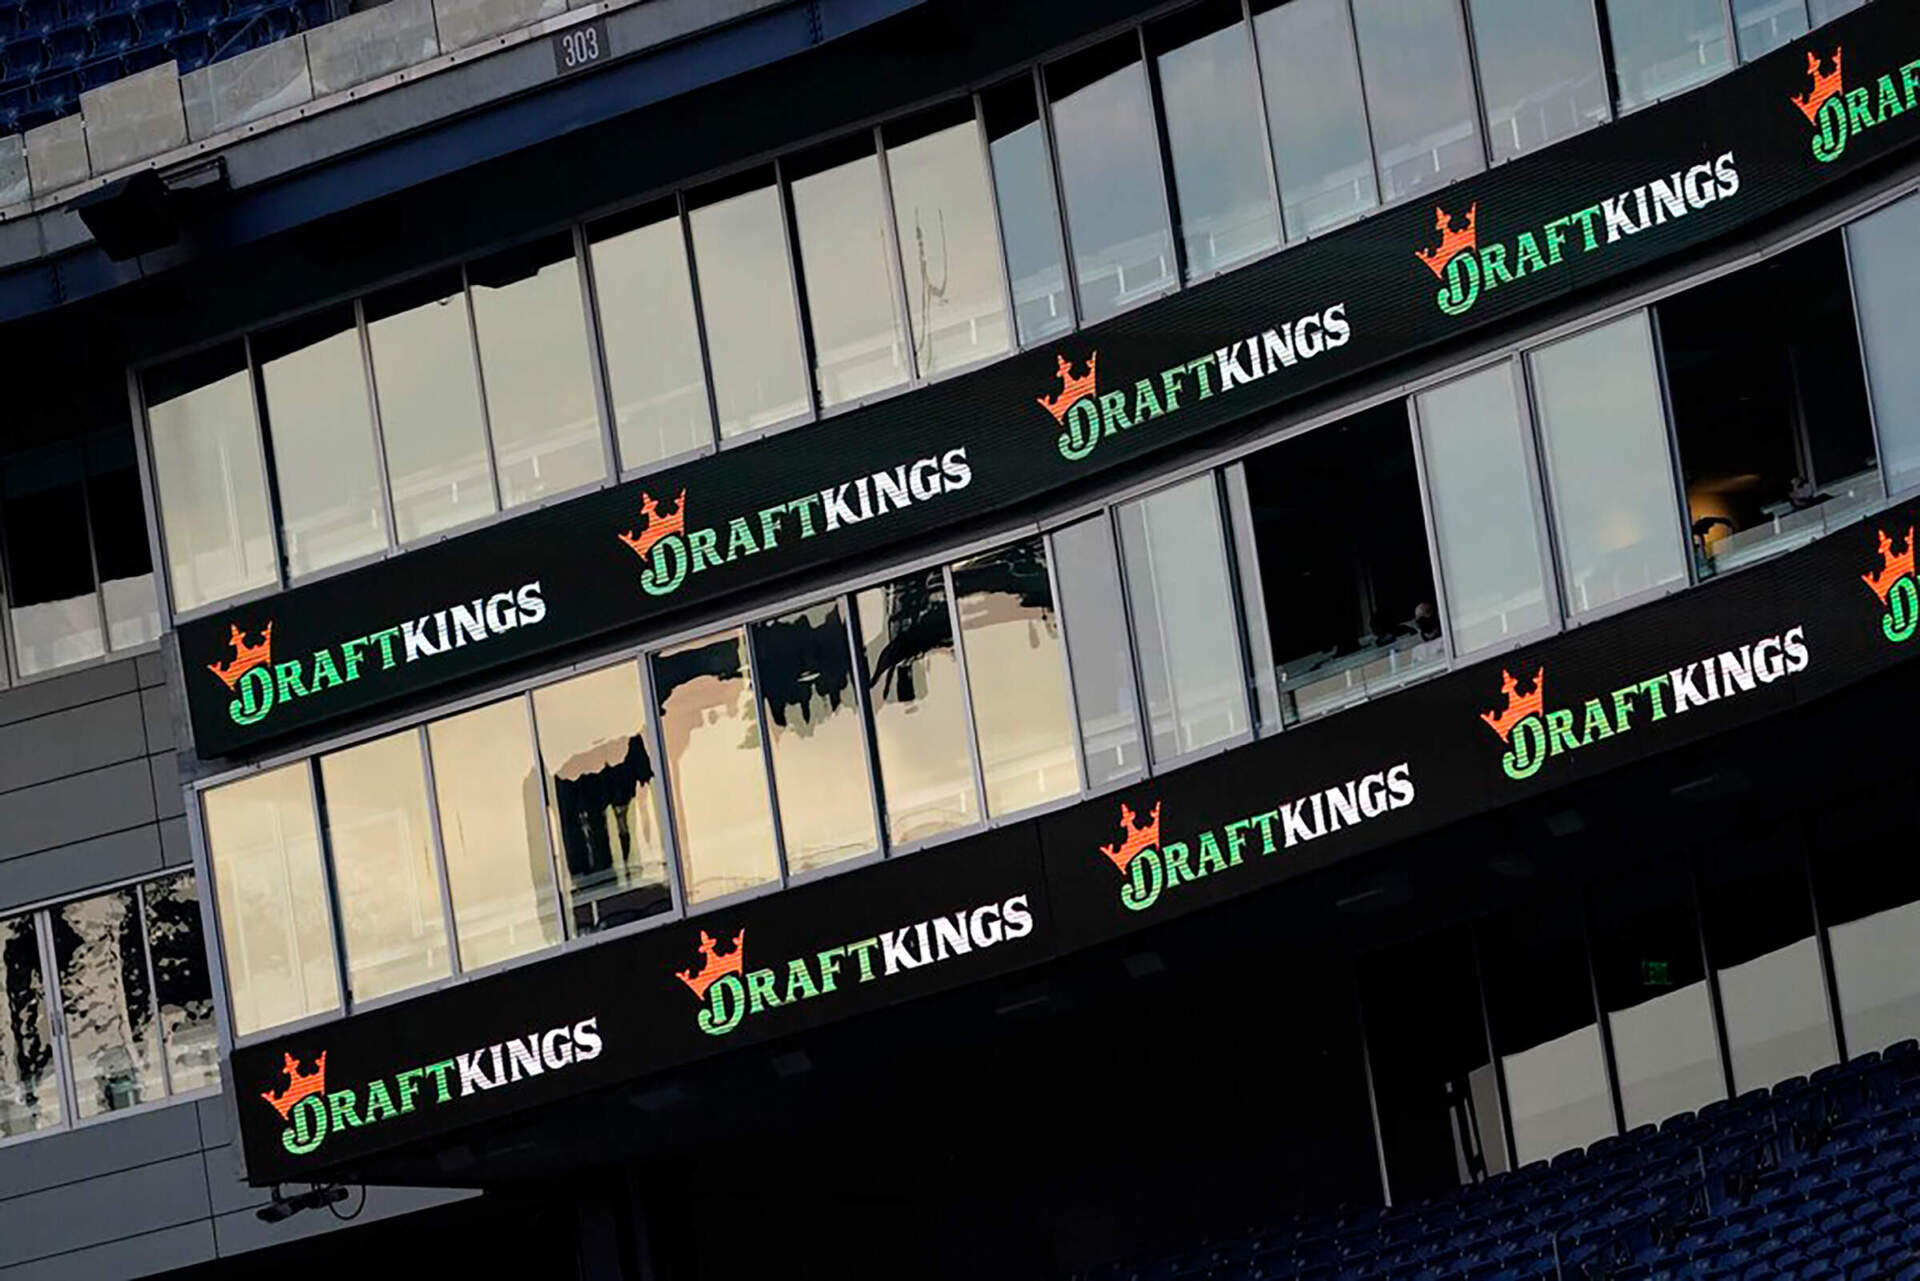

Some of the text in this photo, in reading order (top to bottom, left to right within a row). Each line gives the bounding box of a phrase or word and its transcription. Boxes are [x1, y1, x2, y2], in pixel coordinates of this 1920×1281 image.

[563, 27, 599, 67] 303
[1437, 152, 1739, 316] DRAFTKINGS
[1057, 303, 1350, 460] DRAFTKINGS
[642, 447, 971, 596] DRAFTKINGS
[229, 581, 546, 726] DRAFTKINGS
[1502, 626, 1808, 780] DRAFTKINGS
[1121, 763, 1414, 911] DRAFTKINGS
[698, 895, 1032, 1036] DRAFTKINGS
[283, 1017, 602, 1155] DRAFTKINGS
